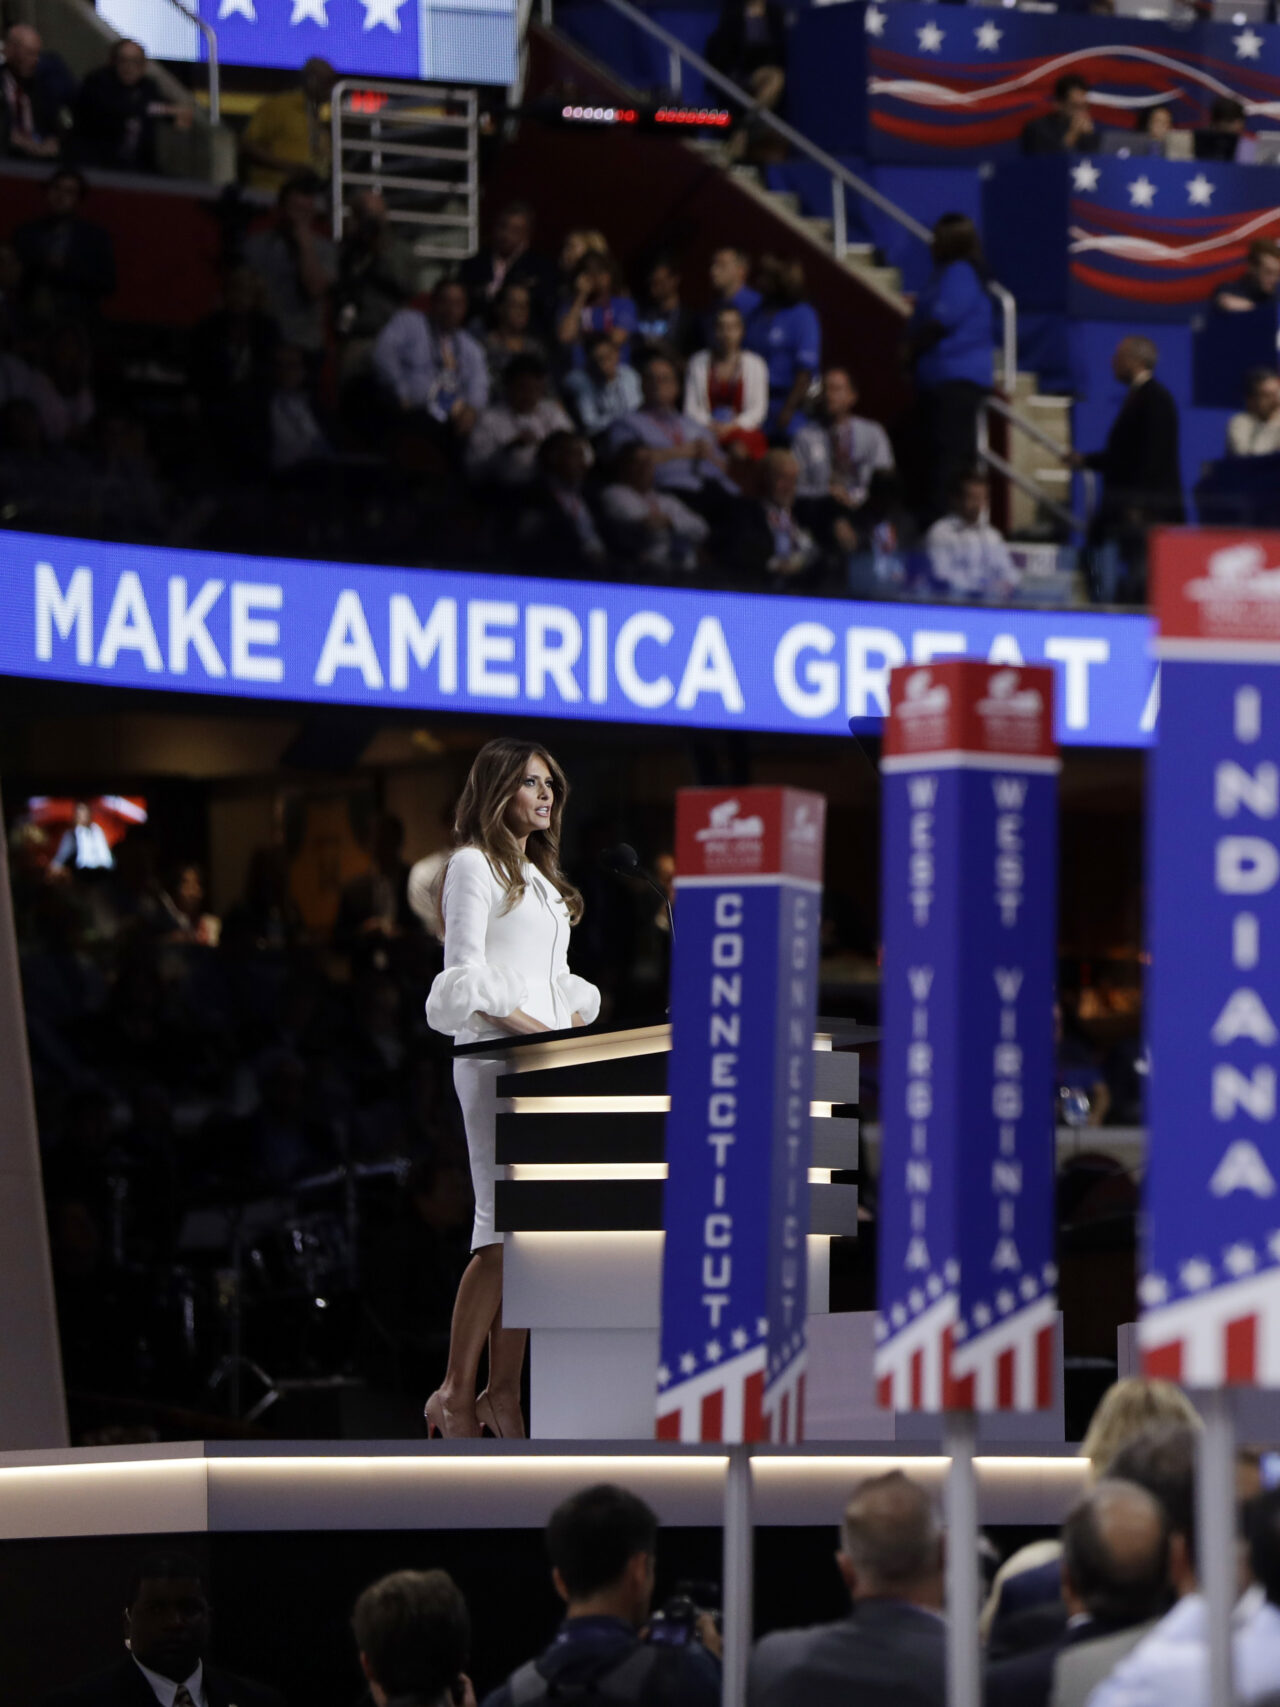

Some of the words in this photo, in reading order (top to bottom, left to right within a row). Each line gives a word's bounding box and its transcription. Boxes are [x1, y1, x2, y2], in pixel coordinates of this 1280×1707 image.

[34, 561, 284, 683] MAKE
[314, 589, 746, 714] AMERICA
[906, 777, 938, 927] WEST
[991, 777, 1028, 927] WEST
[702, 894, 744, 1329] CONNECTICUT
[904, 965, 935, 1271] VIRGINIA
[991, 965, 1024, 1271] VIRGINIA
